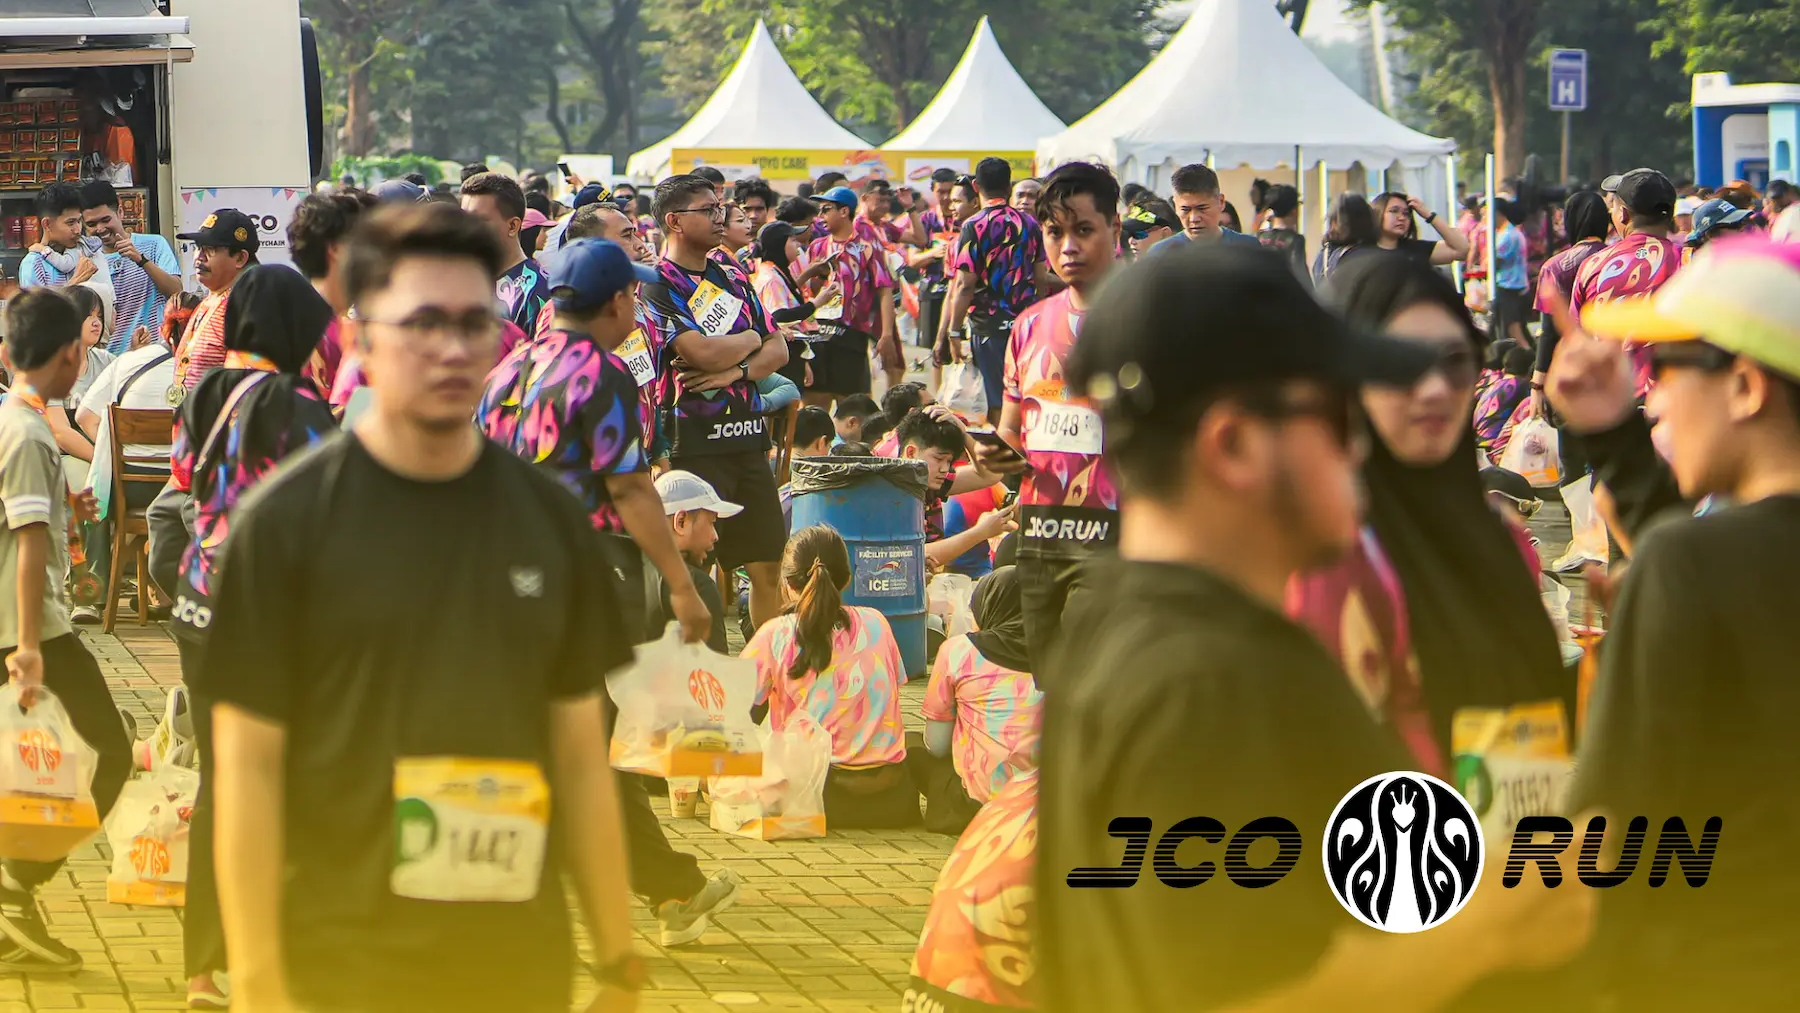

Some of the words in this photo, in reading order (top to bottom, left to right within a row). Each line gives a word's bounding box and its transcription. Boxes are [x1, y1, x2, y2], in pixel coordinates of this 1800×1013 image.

[1557, 79, 1576, 104] H
[702, 303, 727, 333] 8948
[628, 354, 650, 377] 950
[1043, 412, 1079, 437] 1848
[1024, 516, 1109, 540] JCORUN
[868, 579, 890, 592] ICE
